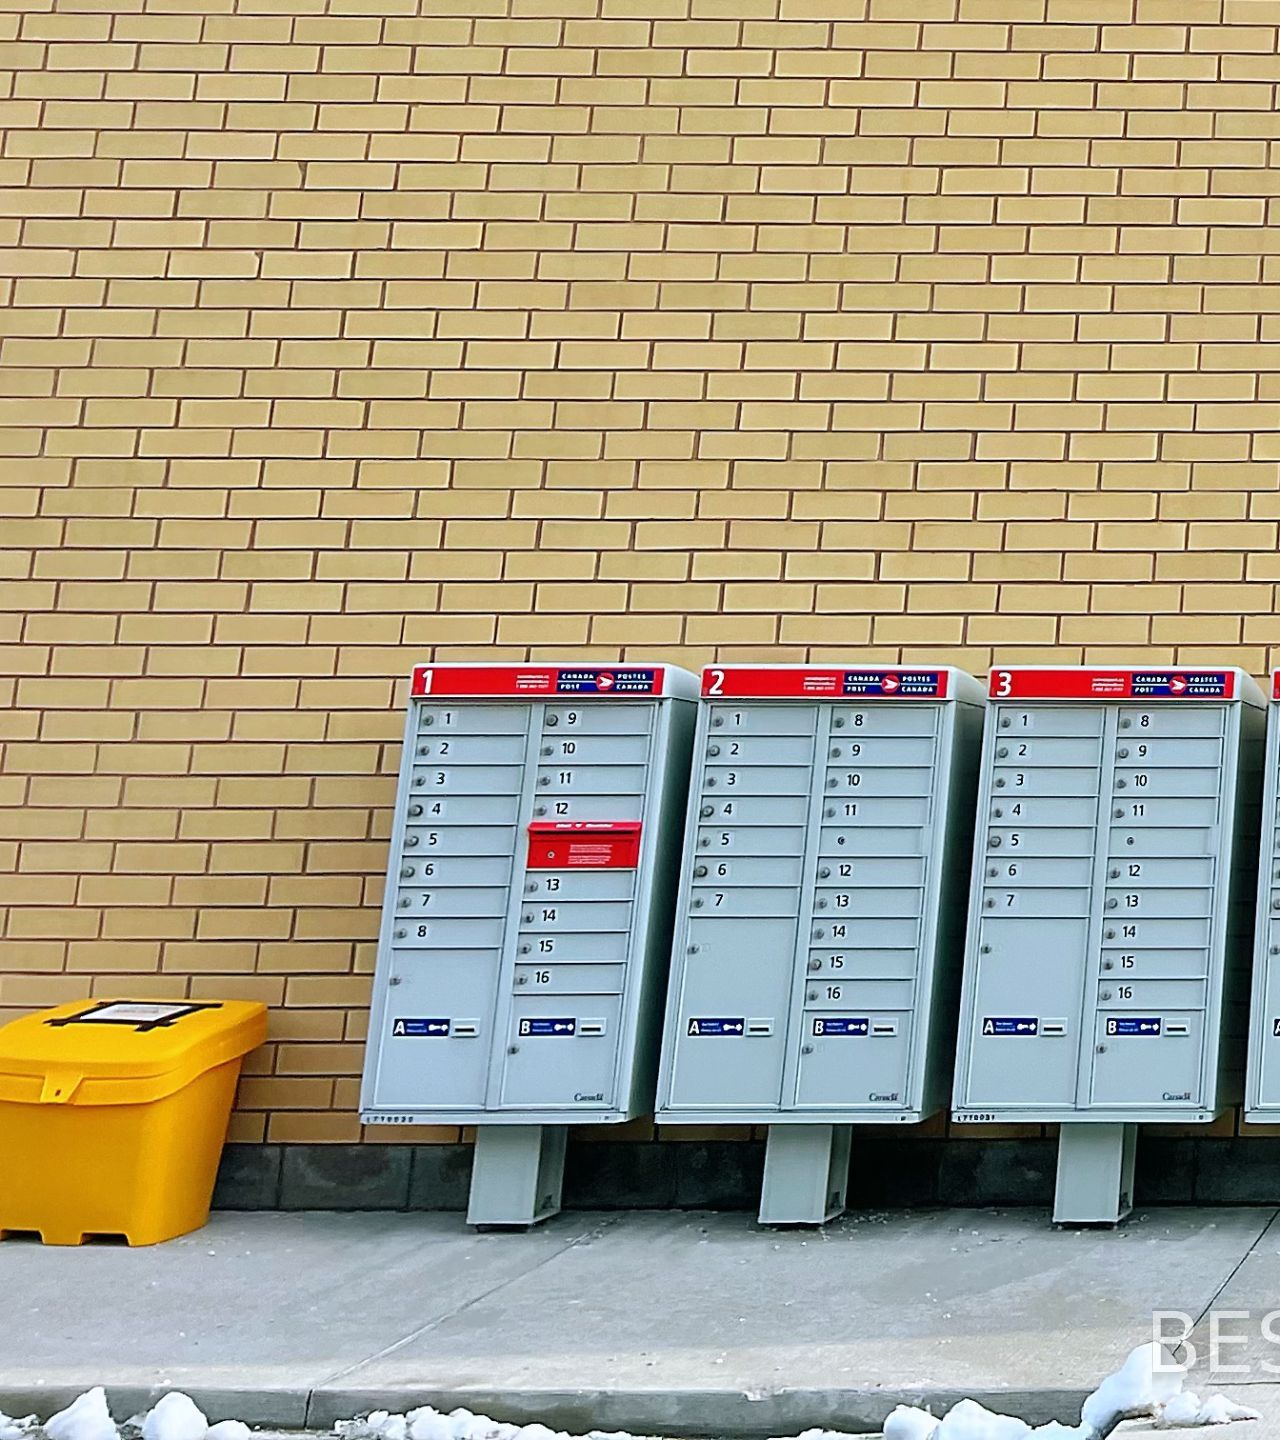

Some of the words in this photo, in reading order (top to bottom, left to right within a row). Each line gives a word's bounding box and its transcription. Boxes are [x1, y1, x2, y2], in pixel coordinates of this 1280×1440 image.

[422, 669, 433, 694] 1
[709, 670, 725, 695] 2
[996, 672, 1013, 698] 3
[1135, 675, 1168, 683] CANADA
[567, 712, 577, 725] 9
[854, 714, 864, 727] 8
[1140, 714, 1150, 728] 8
[439, 742, 449, 755] 2
[562, 742, 576, 754] 10
[730, 742, 739, 756] 2
[852, 744, 861, 757] 9
[1018, 744, 1027, 756] 2
[1138, 744, 1147, 757] 9
[436, 772, 446, 785] 3
[559, 772, 572, 785] 11
[727, 772, 736, 786] 3
[847, 773, 861, 787] 10
[1015, 773, 1024, 787] 3
[1134, 774, 1148, 787] 10
[431, 802, 441, 815] 4
[555, 802, 569, 815] 12
[723, 803, 732, 815] 4
[844, 804, 857, 816] 11
[1012, 803, 1021, 816] 4
[1132, 804, 1144, 817] 11
[428, 832, 438, 846] 5
[721, 832, 730, 846] 5
[1011, 833, 1019, 847] 5
[424, 863, 434, 876] 6
[717, 863, 727, 876] 6
[839, 864, 852, 877] 12
[1008, 863, 1017, 877] 6
[1128, 864, 1141, 877] 12
[546, 878, 560, 891] 13
[422, 893, 431, 907] 7
[715, 893, 724, 907] 7
[835, 894, 850, 908] 13
[1006, 894, 1015, 907] 7
[1125, 894, 1139, 908] 13
[542, 909, 556, 922] 14
[417, 925, 427, 938] 8
[832, 925, 846, 938] 14
[1122, 925, 1136, 938] 14
[539, 939, 554, 953] 15
[830, 955, 844, 969] 15
[1121, 955, 1135, 969] 15
[535, 970, 550, 984] 16
[826, 986, 841, 1000] 16
[1118, 986, 1132, 999] 16
[393, 1020, 405, 1035] A
[520, 1020, 531, 1034] B
[689, 1020, 700, 1035] A
[814, 1020, 824, 1035] B
[983, 1019, 994, 1034] A
[1108, 1020, 1117, 1034] B
